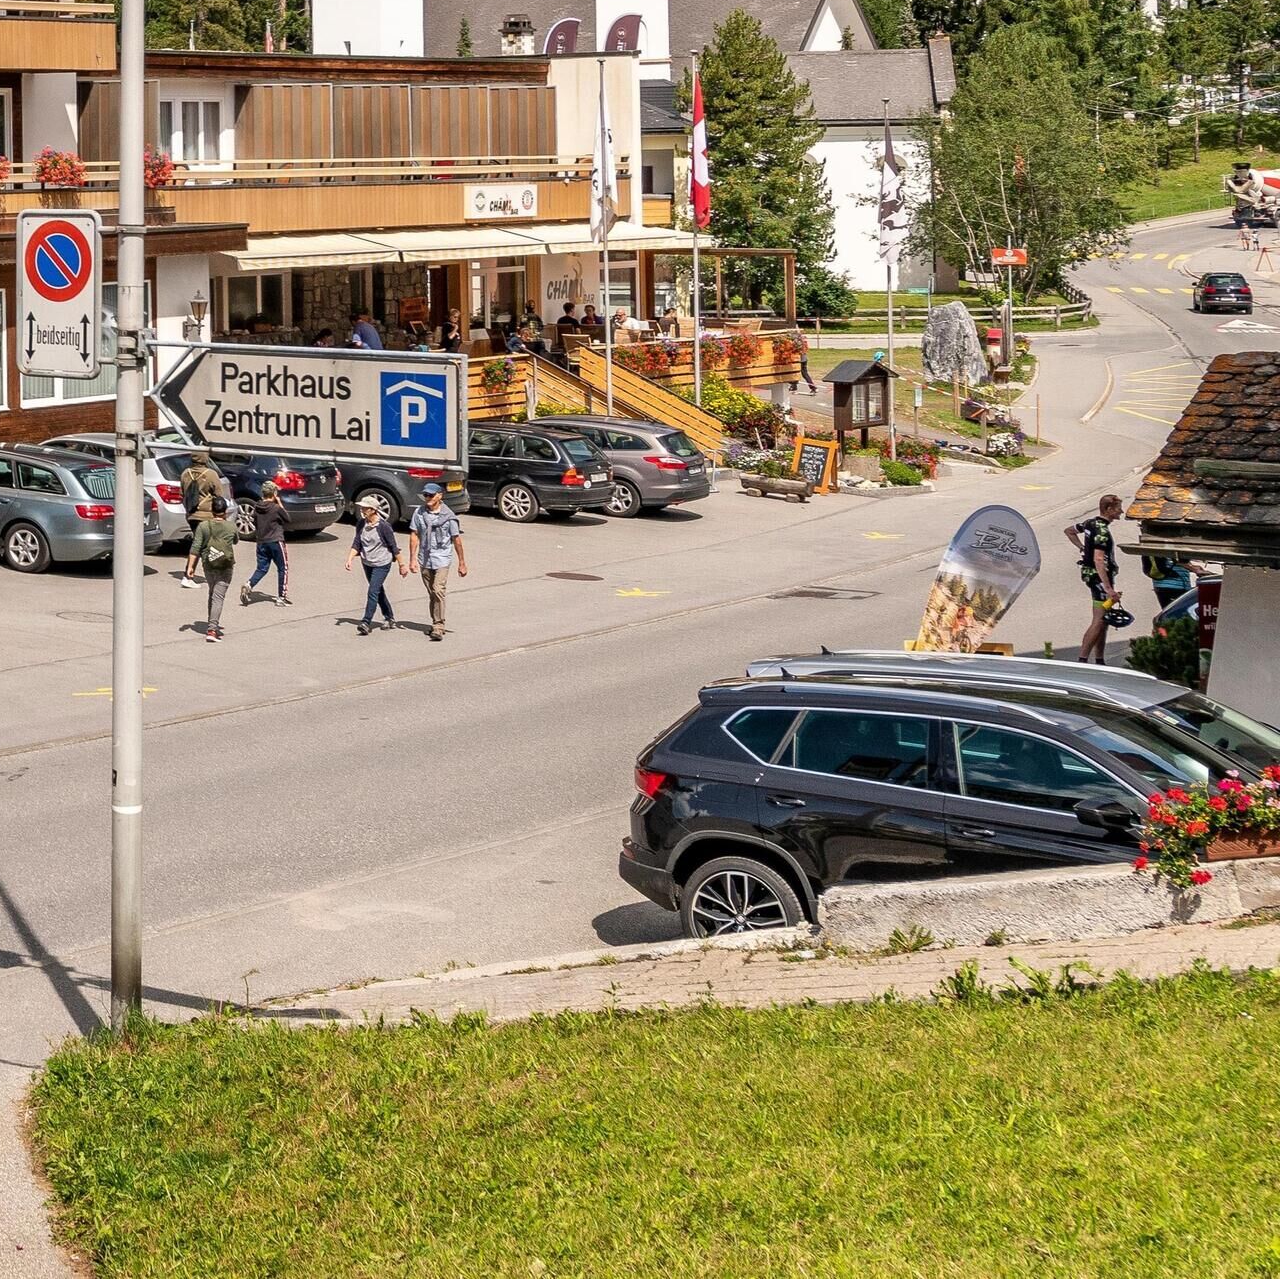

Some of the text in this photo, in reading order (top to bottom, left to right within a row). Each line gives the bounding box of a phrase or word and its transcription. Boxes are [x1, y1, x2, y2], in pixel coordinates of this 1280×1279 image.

[36, 324, 81, 351] beidseitig
[220, 362, 352, 401] Parkhaus
[204, 399, 371, 442] Zentrum Lai
[970, 529, 1029, 556] Bike
